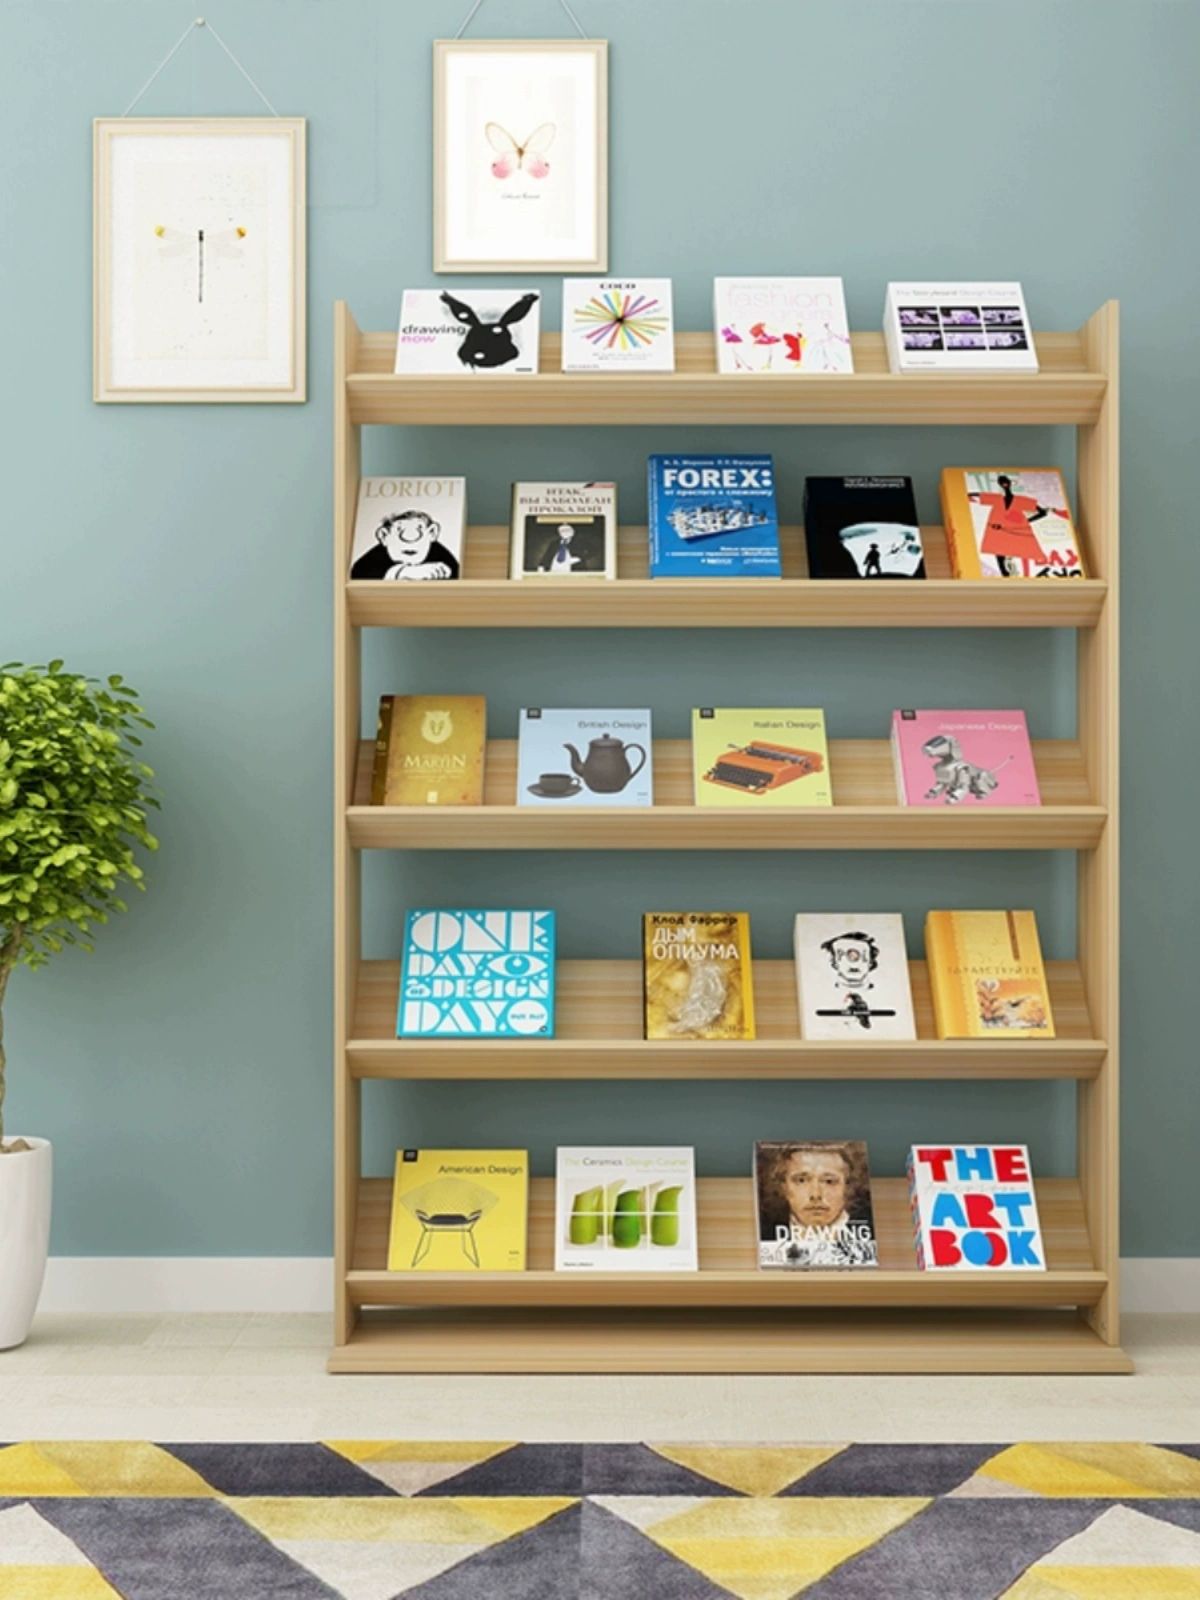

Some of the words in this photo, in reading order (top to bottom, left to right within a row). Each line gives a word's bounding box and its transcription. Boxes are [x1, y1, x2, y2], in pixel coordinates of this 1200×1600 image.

[402, 324, 467, 336] drawing
[401, 335, 436, 344] now
[663, 468, 772, 488] FOREX:
[365, 480, 461, 498] LORIOT
[577, 720, 610, 728] British
[612, 720, 647, 730] Design
[753, 720, 783, 728] Italian
[786, 720, 822, 730] Design
[937, 722, 986, 731] Japanese
[987, 722, 1023, 732] Design
[653, 915, 684, 925] Клод
[689, 915, 738, 925] Фаррер
[410, 911, 551, 952] ONE
[652, 928, 696, 944] ДЫМ
[653, 944, 740, 960] ОПИУМА
[407, 953, 485, 976] DAY
[432, 979, 549, 998] DESIGN
[582, 1157, 623, 1167] Ceramics
[917, 1147, 1029, 1183] THE
[438, 1165, 485, 1174] American
[488, 1165, 523, 1176] Design
[931, 1191, 1032, 1229] ART
[775, 1225, 871, 1242] DRAWING
[930, 1229, 1041, 1266] BOOK
